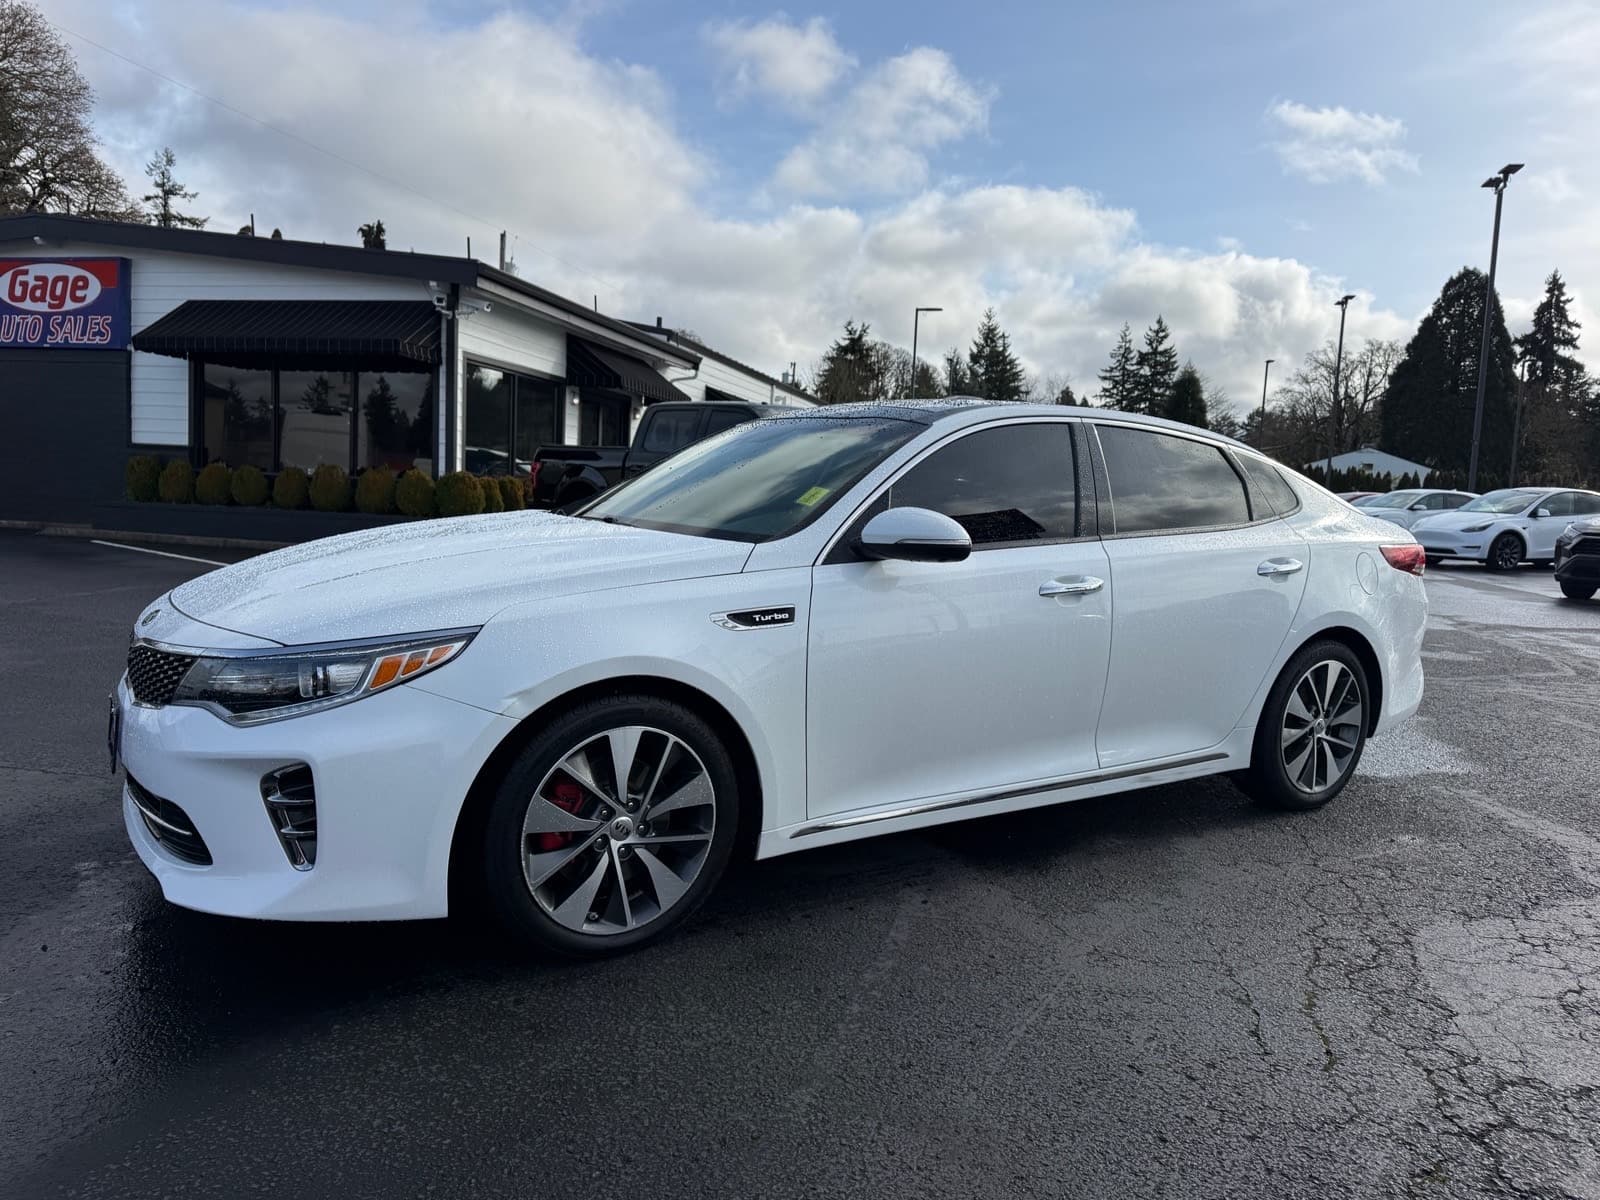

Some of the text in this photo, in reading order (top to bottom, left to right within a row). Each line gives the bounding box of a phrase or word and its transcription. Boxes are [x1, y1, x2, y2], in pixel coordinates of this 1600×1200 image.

[8, 268, 90, 310] Gage
[0, 314, 112, 344] UTO SALES
[753, 612, 789, 622] Turbo
